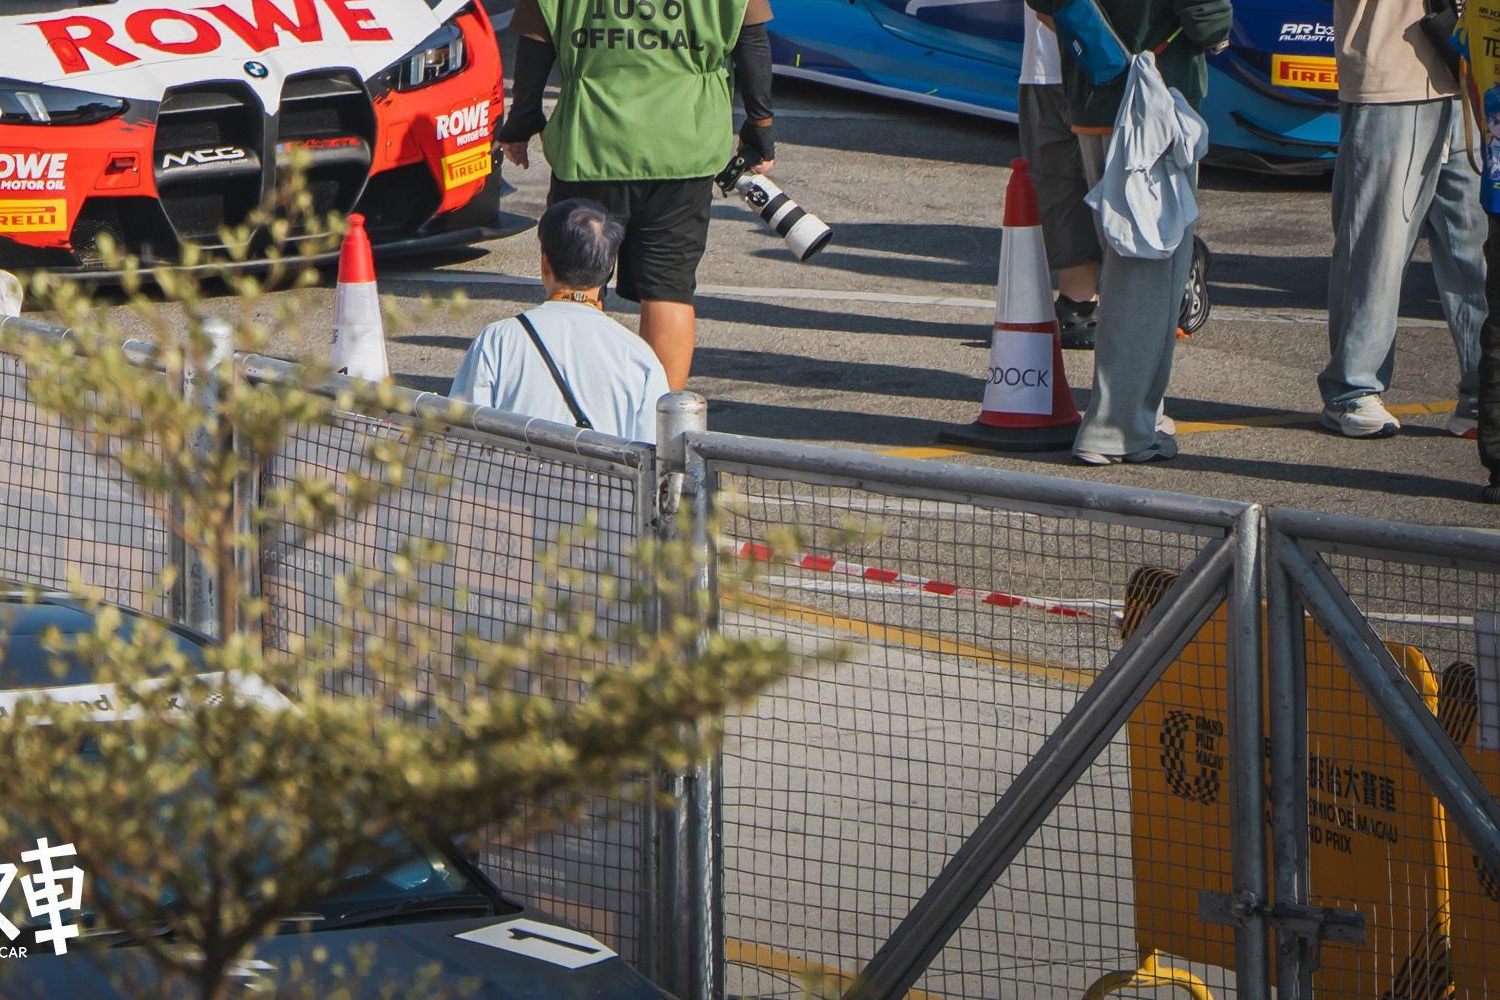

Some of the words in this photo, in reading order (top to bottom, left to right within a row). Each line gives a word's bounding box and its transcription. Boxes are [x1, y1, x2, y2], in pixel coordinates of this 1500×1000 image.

[570, 28, 705, 52] OFFICIAL
[436, 100, 490, 140] ROWE
[449, 151, 488, 181] PIRELLI
[0, 180, 44, 191] MOTOR
[46, 180, 66, 191] OIL
